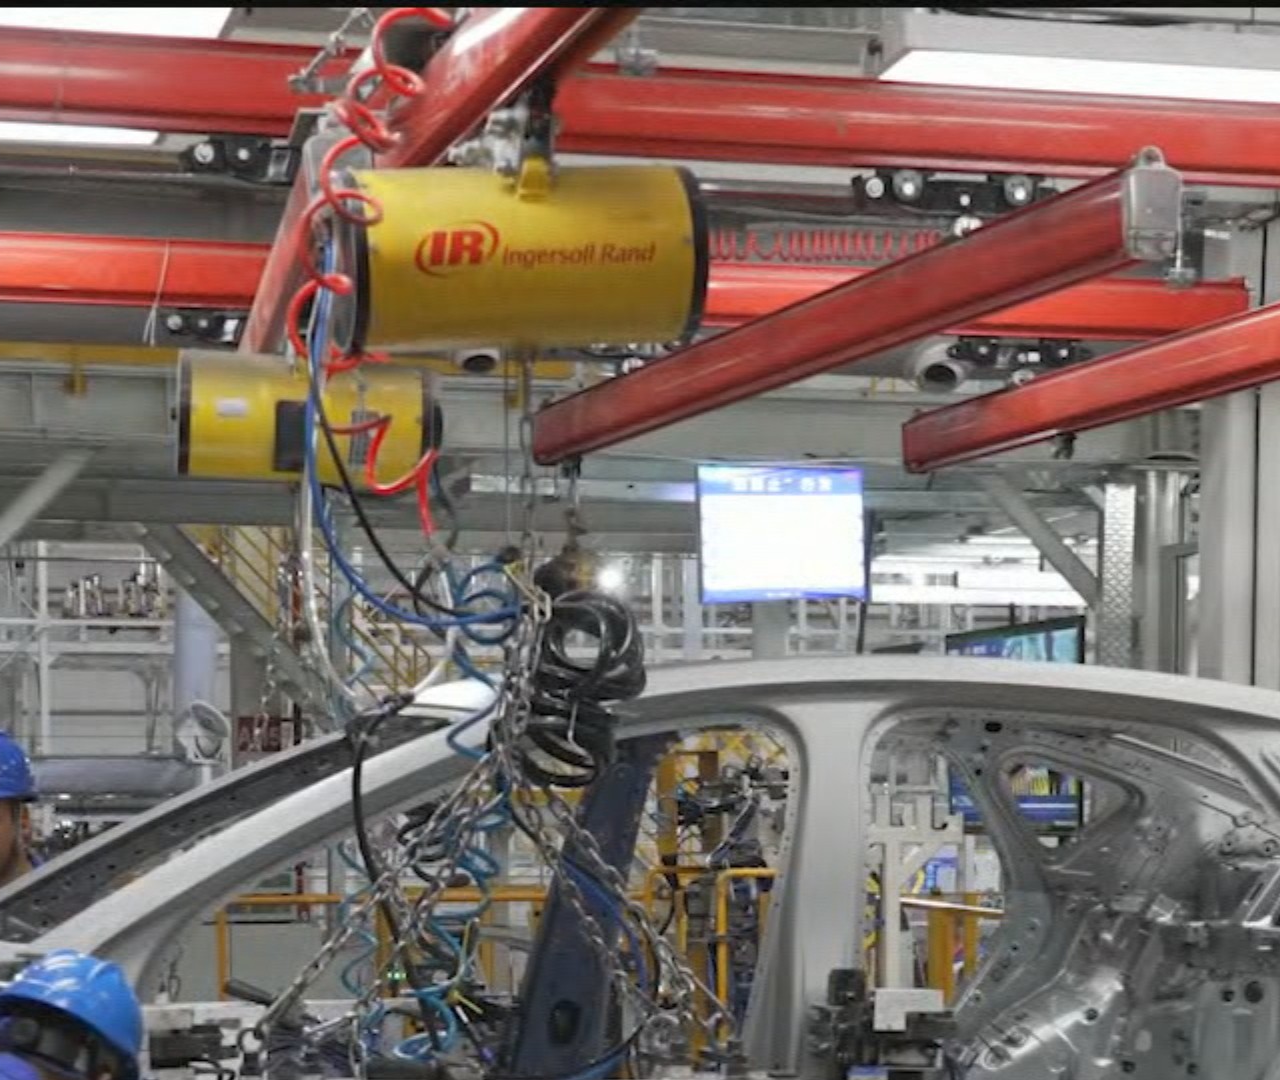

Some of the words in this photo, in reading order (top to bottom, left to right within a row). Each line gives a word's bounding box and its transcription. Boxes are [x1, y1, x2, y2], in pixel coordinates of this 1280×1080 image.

[429, 230, 485, 266] IR
[503, 244, 595, 269] Ingersoll
[601, 241, 657, 264] Rand
